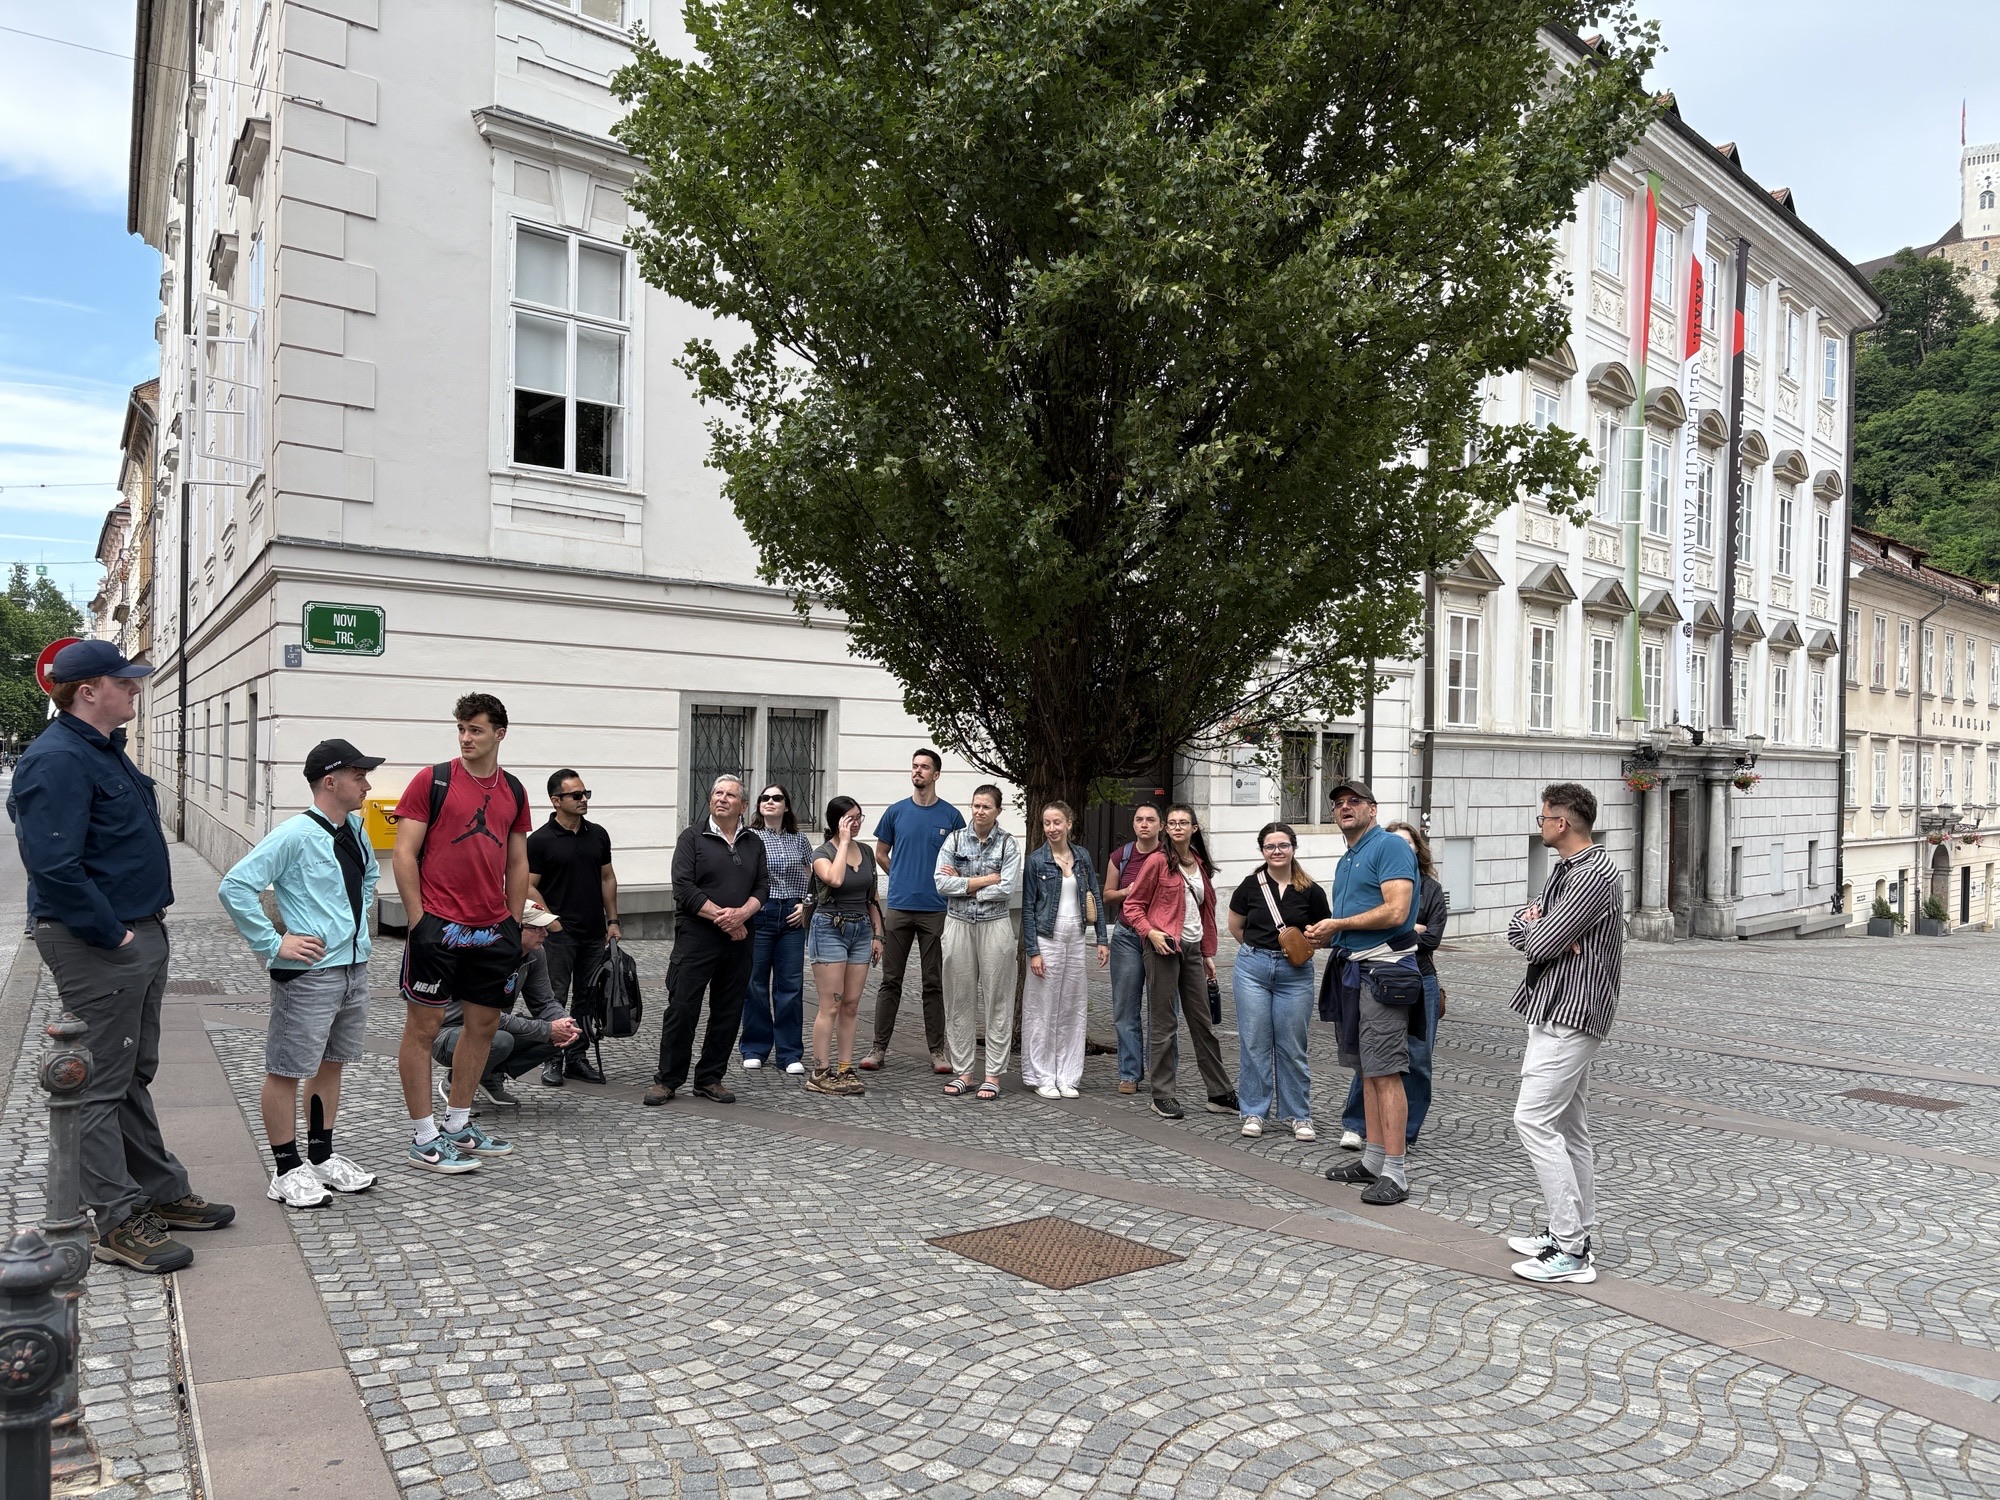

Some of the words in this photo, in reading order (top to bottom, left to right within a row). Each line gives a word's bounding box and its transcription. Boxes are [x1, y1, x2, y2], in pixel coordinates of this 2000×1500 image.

[1685, 363, 1700, 489] GENERACIJE
[1683, 499, 1697, 603] ZNANOSTI
[333, 613, 357, 627] NOVI
[335, 631, 354, 644] TRG
[413, 979, 442, 994] HEAT
